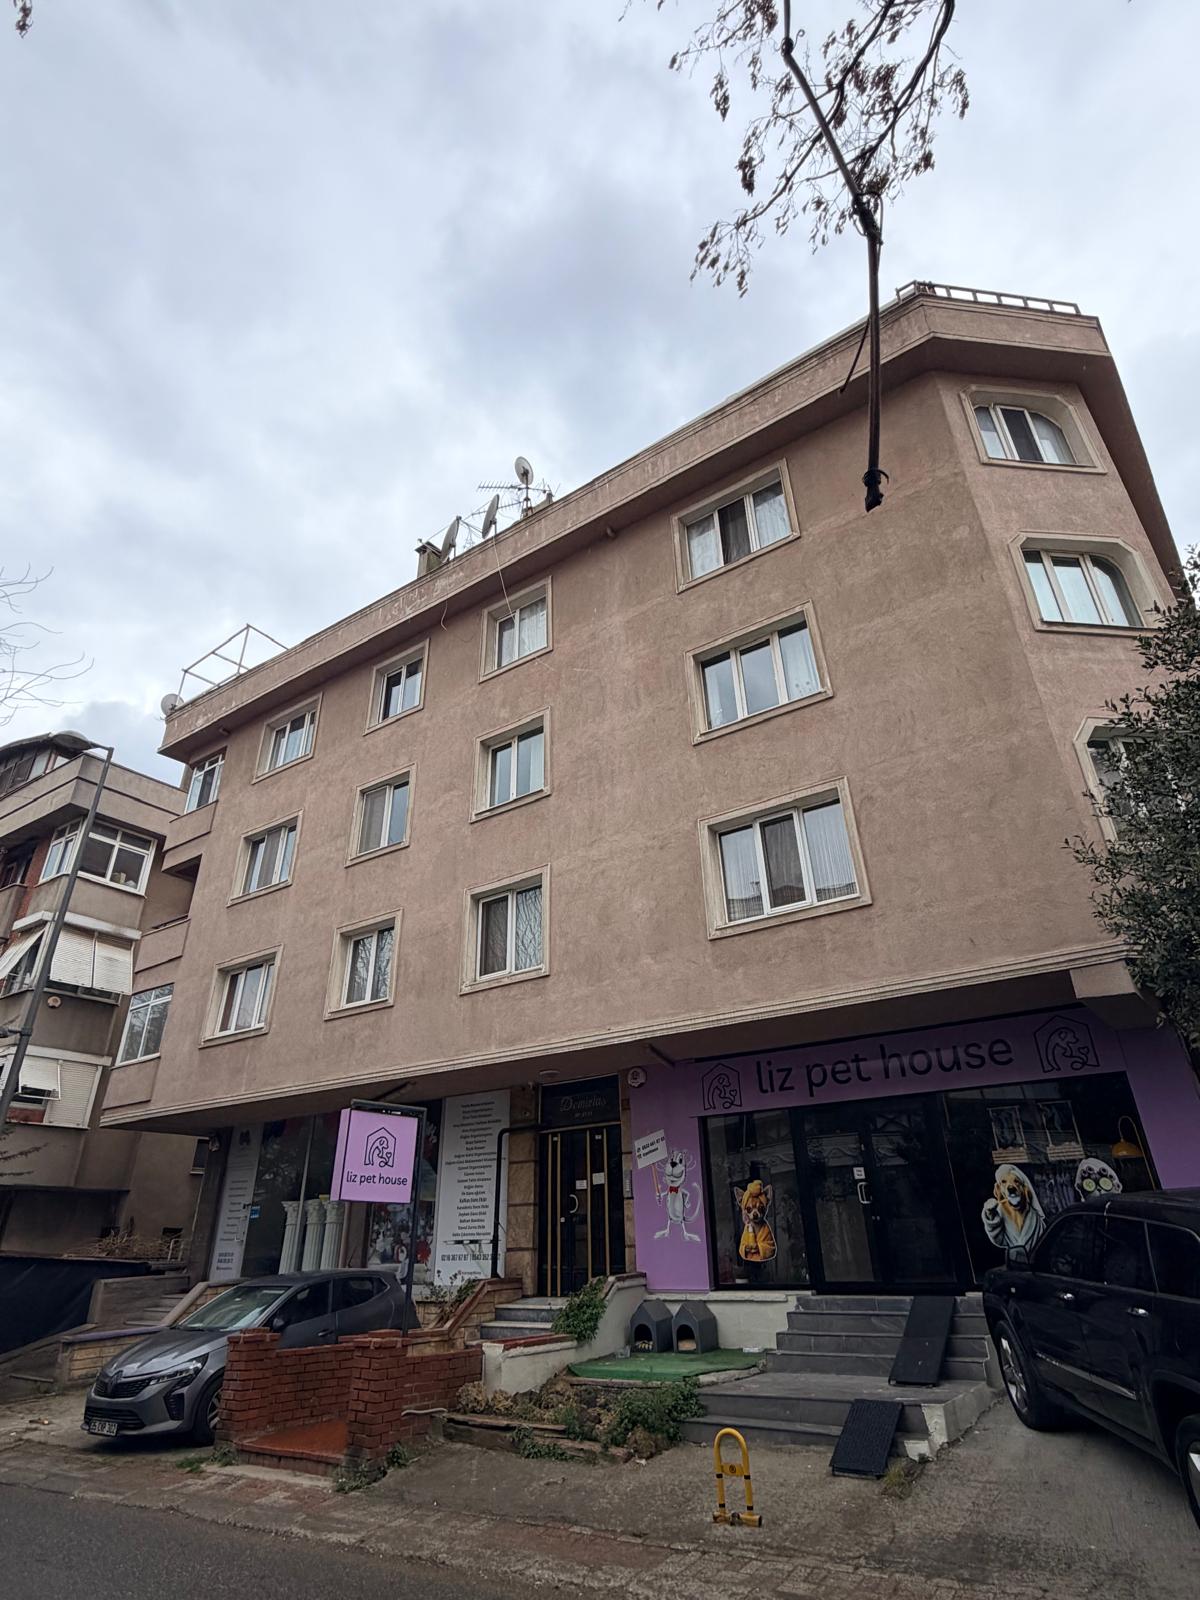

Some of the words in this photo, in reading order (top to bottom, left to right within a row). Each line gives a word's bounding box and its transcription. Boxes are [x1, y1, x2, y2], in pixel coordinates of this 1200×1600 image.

[755, 1060, 795, 1094] liz
[805, 1052, 872, 1097] pet
[879, 1037, 1015, 1080] house
[346, 1170, 358, 1183] liz
[359, 1173, 377, 1187] pet
[378, 1173, 408, 1186] house
